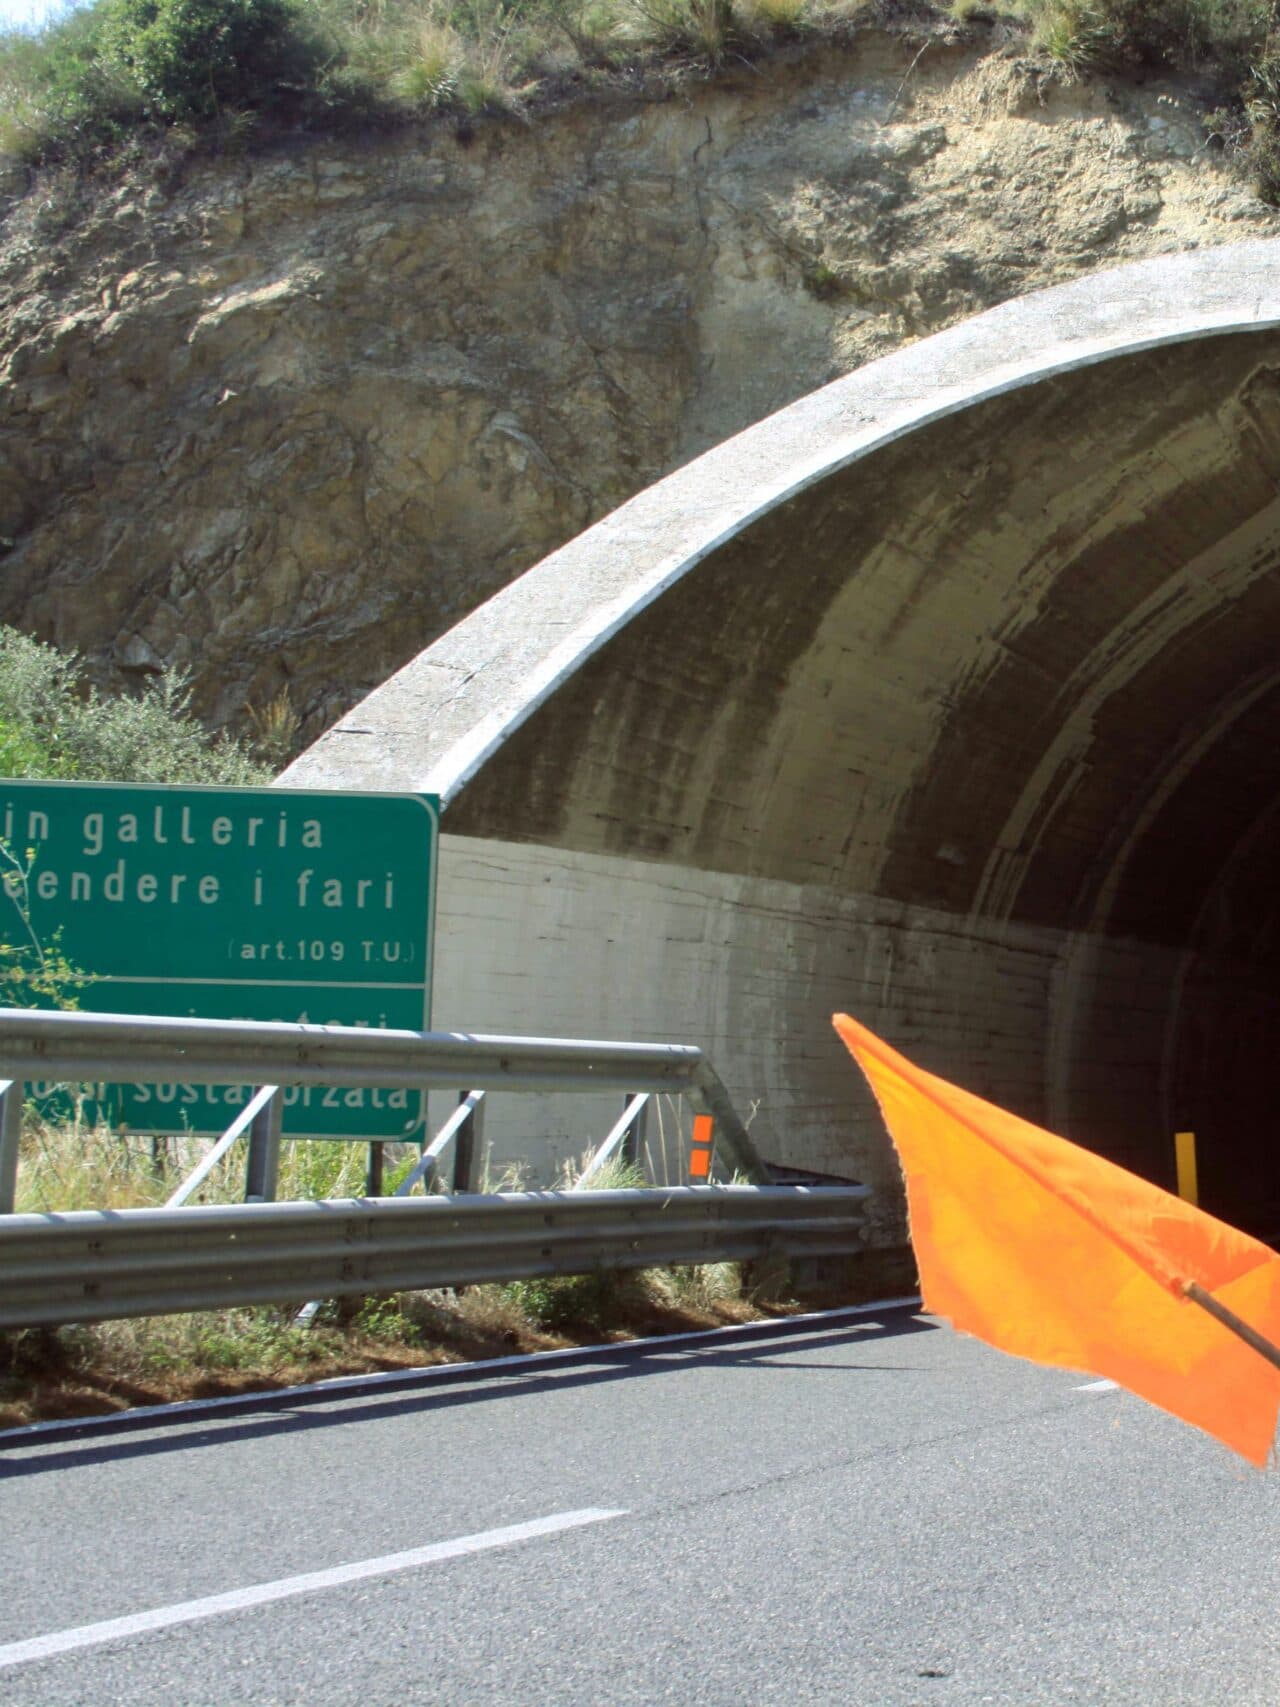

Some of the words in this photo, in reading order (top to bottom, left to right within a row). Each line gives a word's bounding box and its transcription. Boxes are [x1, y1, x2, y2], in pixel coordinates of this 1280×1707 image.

[5, 802, 49, 840] in
[82, 805, 323, 856] galleria
[253, 870, 264, 906] i
[298, 869, 397, 909] fari
